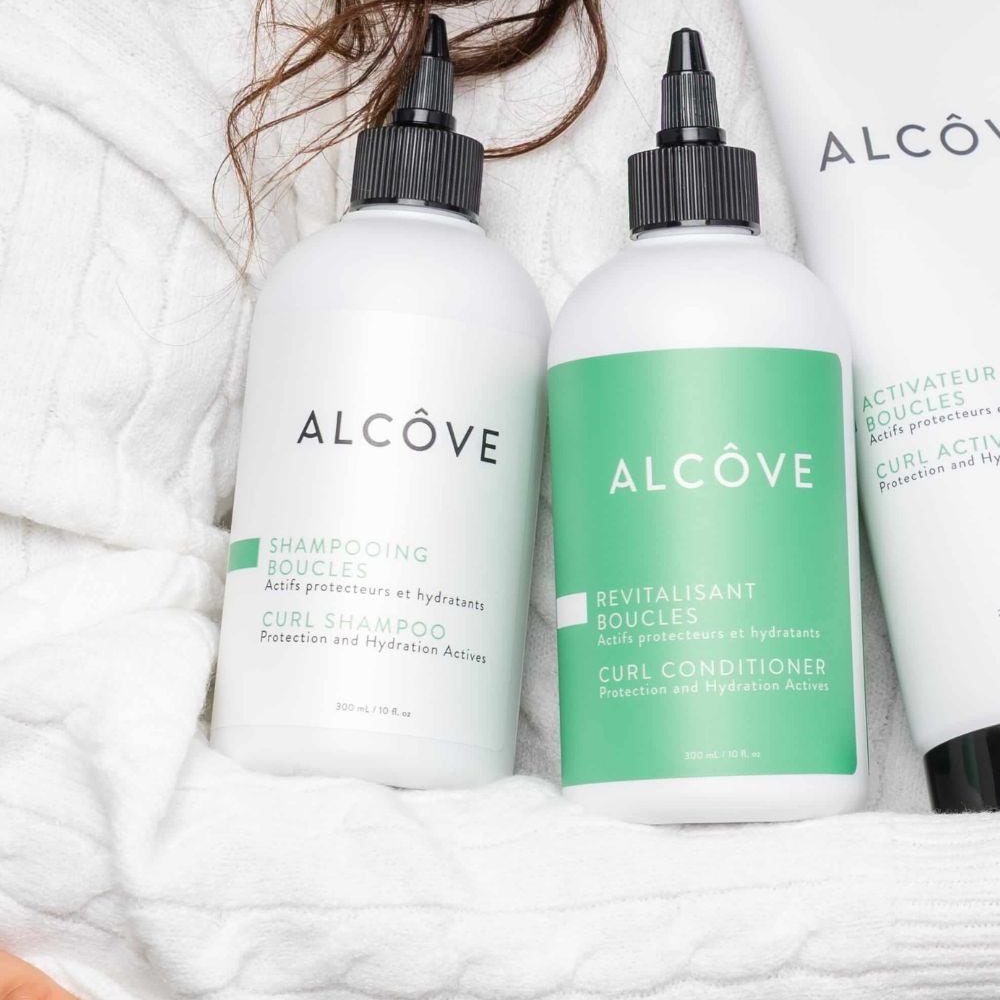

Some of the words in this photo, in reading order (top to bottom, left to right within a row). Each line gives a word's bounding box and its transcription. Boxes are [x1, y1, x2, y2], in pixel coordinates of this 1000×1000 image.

[862, 365, 996, 412] ACTIVATEUR
[866, 391, 965, 432] BOUCLES
[870, 425, 904, 446] Actifs
[910, 406, 991, 434] protecteurs
[297, 407, 499, 464] ALCÔVE
[609, 442, 813, 495] ALCÔVE
[876, 450, 928, 479] CURL
[879, 465, 945, 493] Protection
[951, 456, 975, 470] and
[269, 537, 428, 563] SHAMPOOING
[267, 560, 368, 579] BOUCLES
[265, 579, 300, 592] Actifs
[306, 581, 390, 597] protecteurs
[397, 587, 411, 599] et
[417, 588, 485, 612] hydratants
[596, 582, 756, 607] REVITALISANT
[262, 611, 314, 628] CURL
[325, 613, 446, 640] SHAMPOO
[598, 608, 698, 631] BOUCLES
[260, 630, 327, 644] Protection
[333, 634, 358, 646] and
[366, 636, 438, 655] Hydration
[443, 645, 487, 664] Actives
[597, 631, 633, 646] Actifs
[638, 628, 724, 647] protecteurs
[730, 627, 745, 639] et
[751, 626, 820, 641] hydratants
[599, 663, 652, 683] CURL
[661, 658, 826, 679] CONDITIONER
[599, 683, 667, 699] Protection
[673, 681, 698, 694] and
[705, 680, 780, 695] Hydration
[785, 678, 829, 692] Actives
